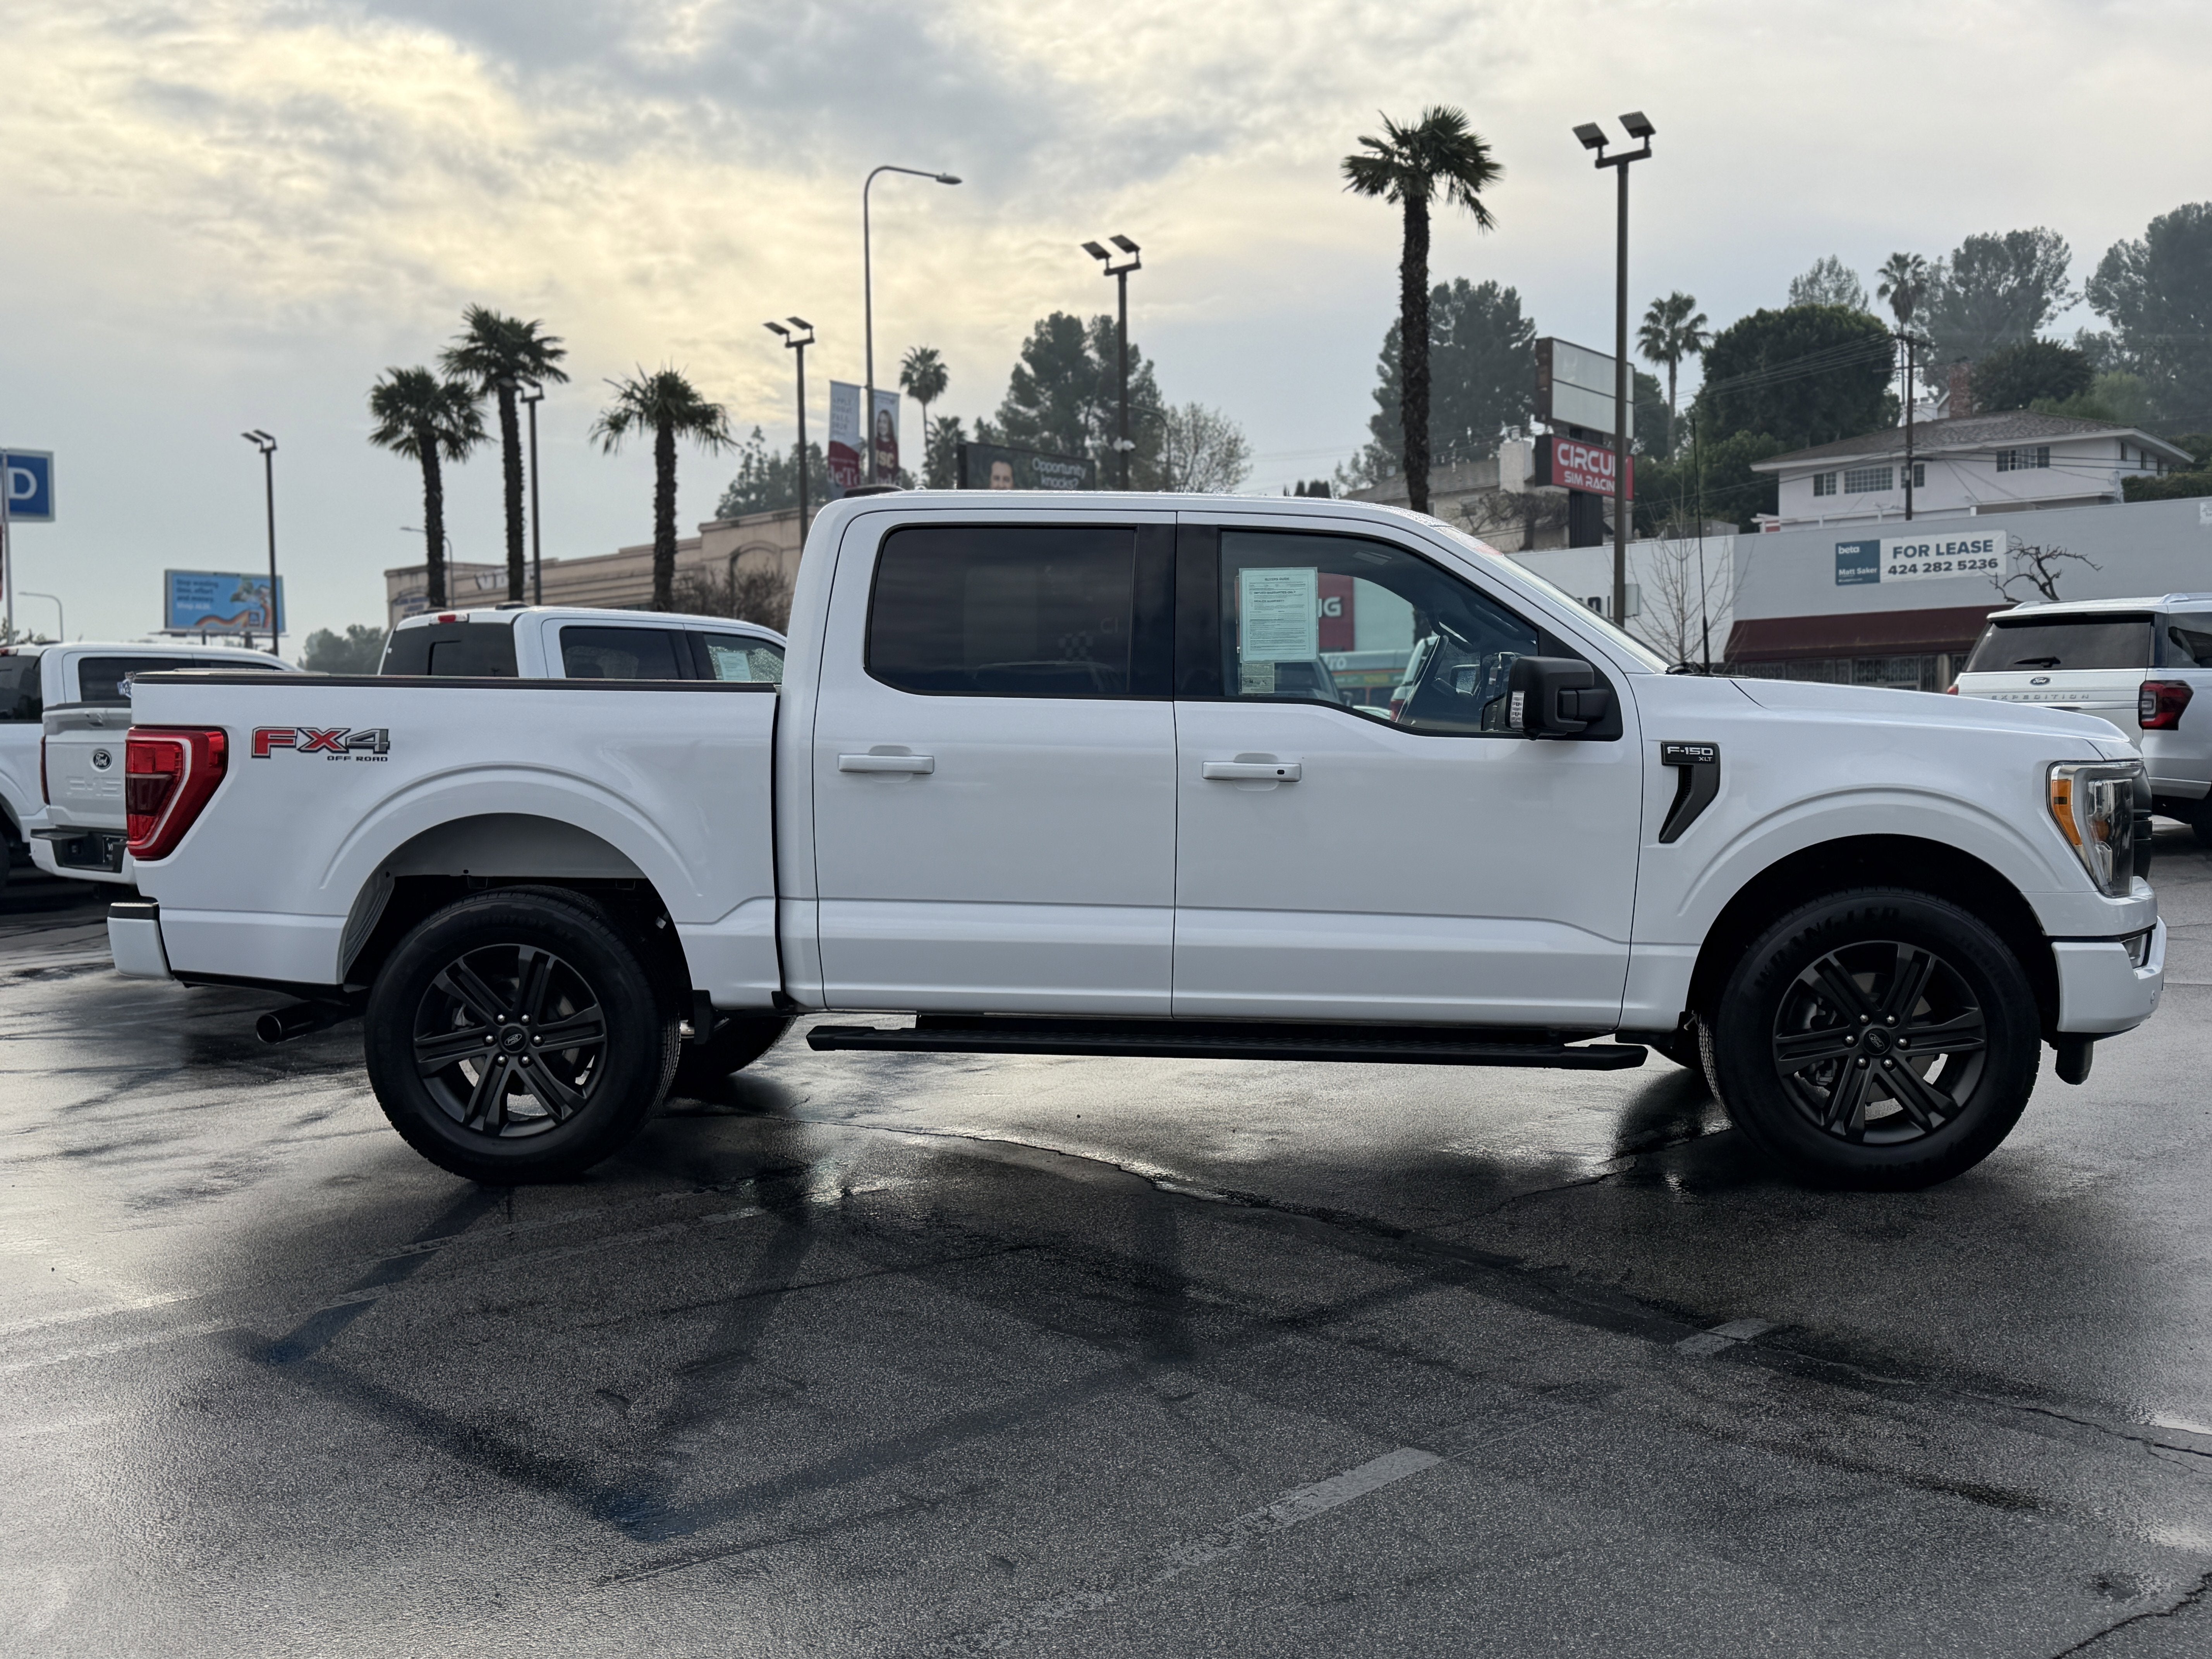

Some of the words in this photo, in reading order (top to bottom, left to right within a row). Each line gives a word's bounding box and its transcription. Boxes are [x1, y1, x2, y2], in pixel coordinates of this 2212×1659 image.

[1032, 457, 1086, 479] Opportunity
[1558, 443, 1616, 477] CIRCUI
[1041, 474, 1079, 489] knocks?
[1565, 470, 1583, 486] SIM
[1585, 475, 1616, 493] RACIN
[1838, 545, 1860, 555] beta
[1893, 544, 1930, 559] FOR
[1936, 539, 1994, 556] LEASE
[1888, 563, 1918, 575] 424
[1922, 561, 1953, 572] 282
[1957, 558, 1999, 570] 5236
[252, 726, 390, 759] FX4
[1667, 746, 1714, 756] F-150
[94, 752, 110, 768] Ford
[1753, 907, 1901, 991] WRANGLER
